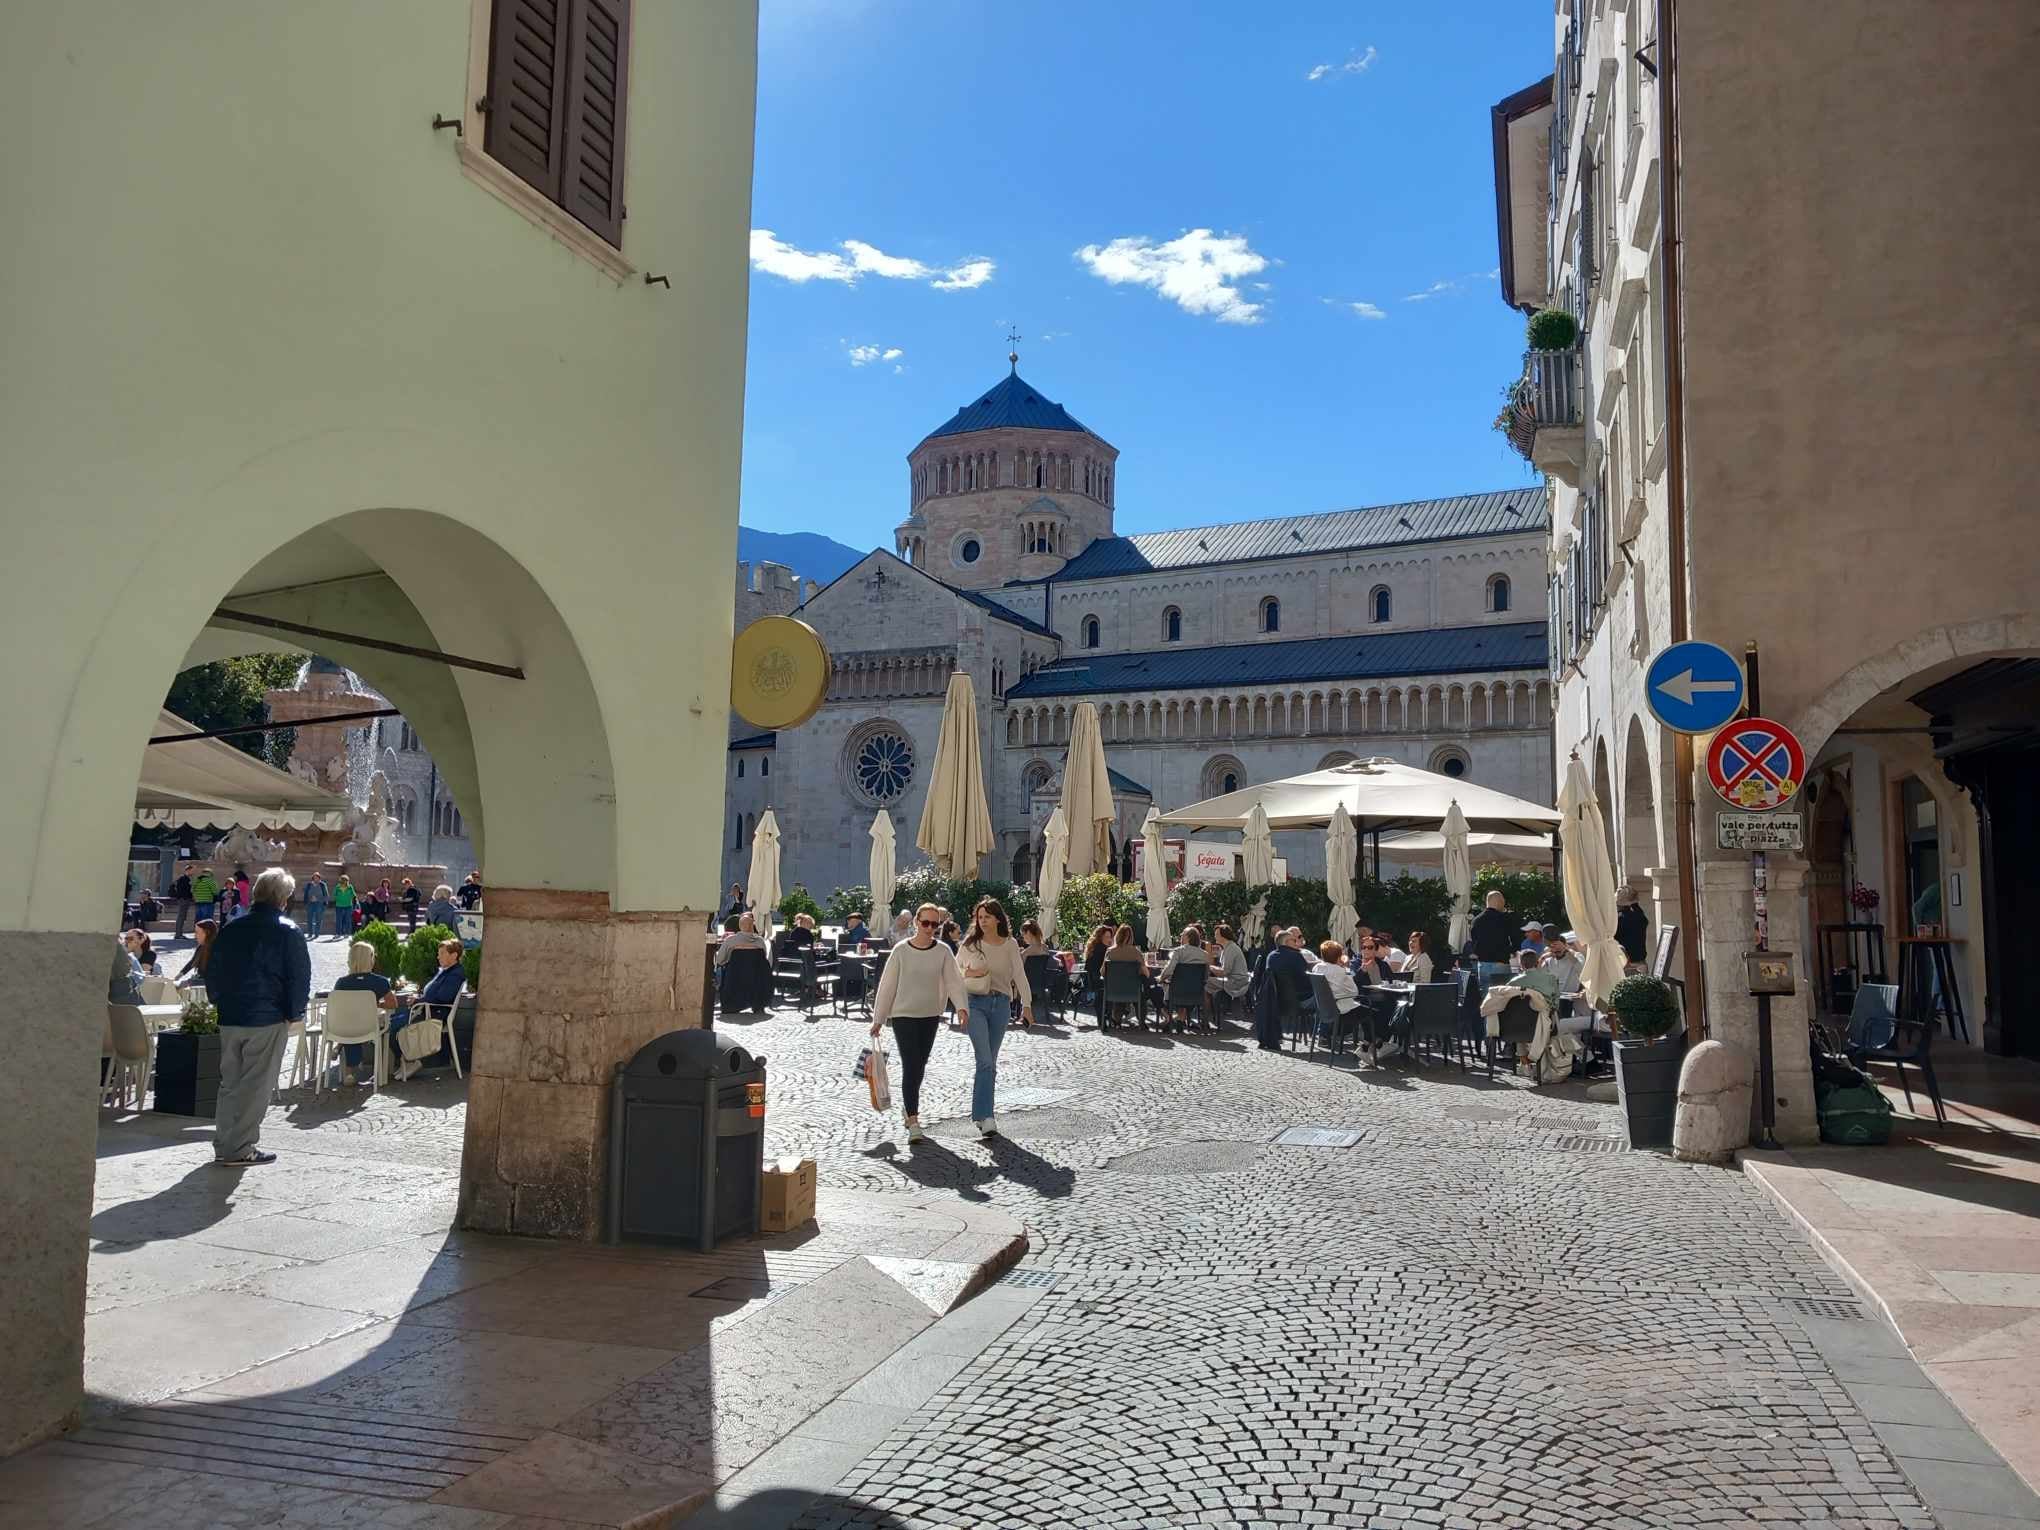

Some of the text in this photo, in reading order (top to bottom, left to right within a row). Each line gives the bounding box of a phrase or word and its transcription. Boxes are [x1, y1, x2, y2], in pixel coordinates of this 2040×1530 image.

[1721, 821, 1798, 831] vale per tutta
